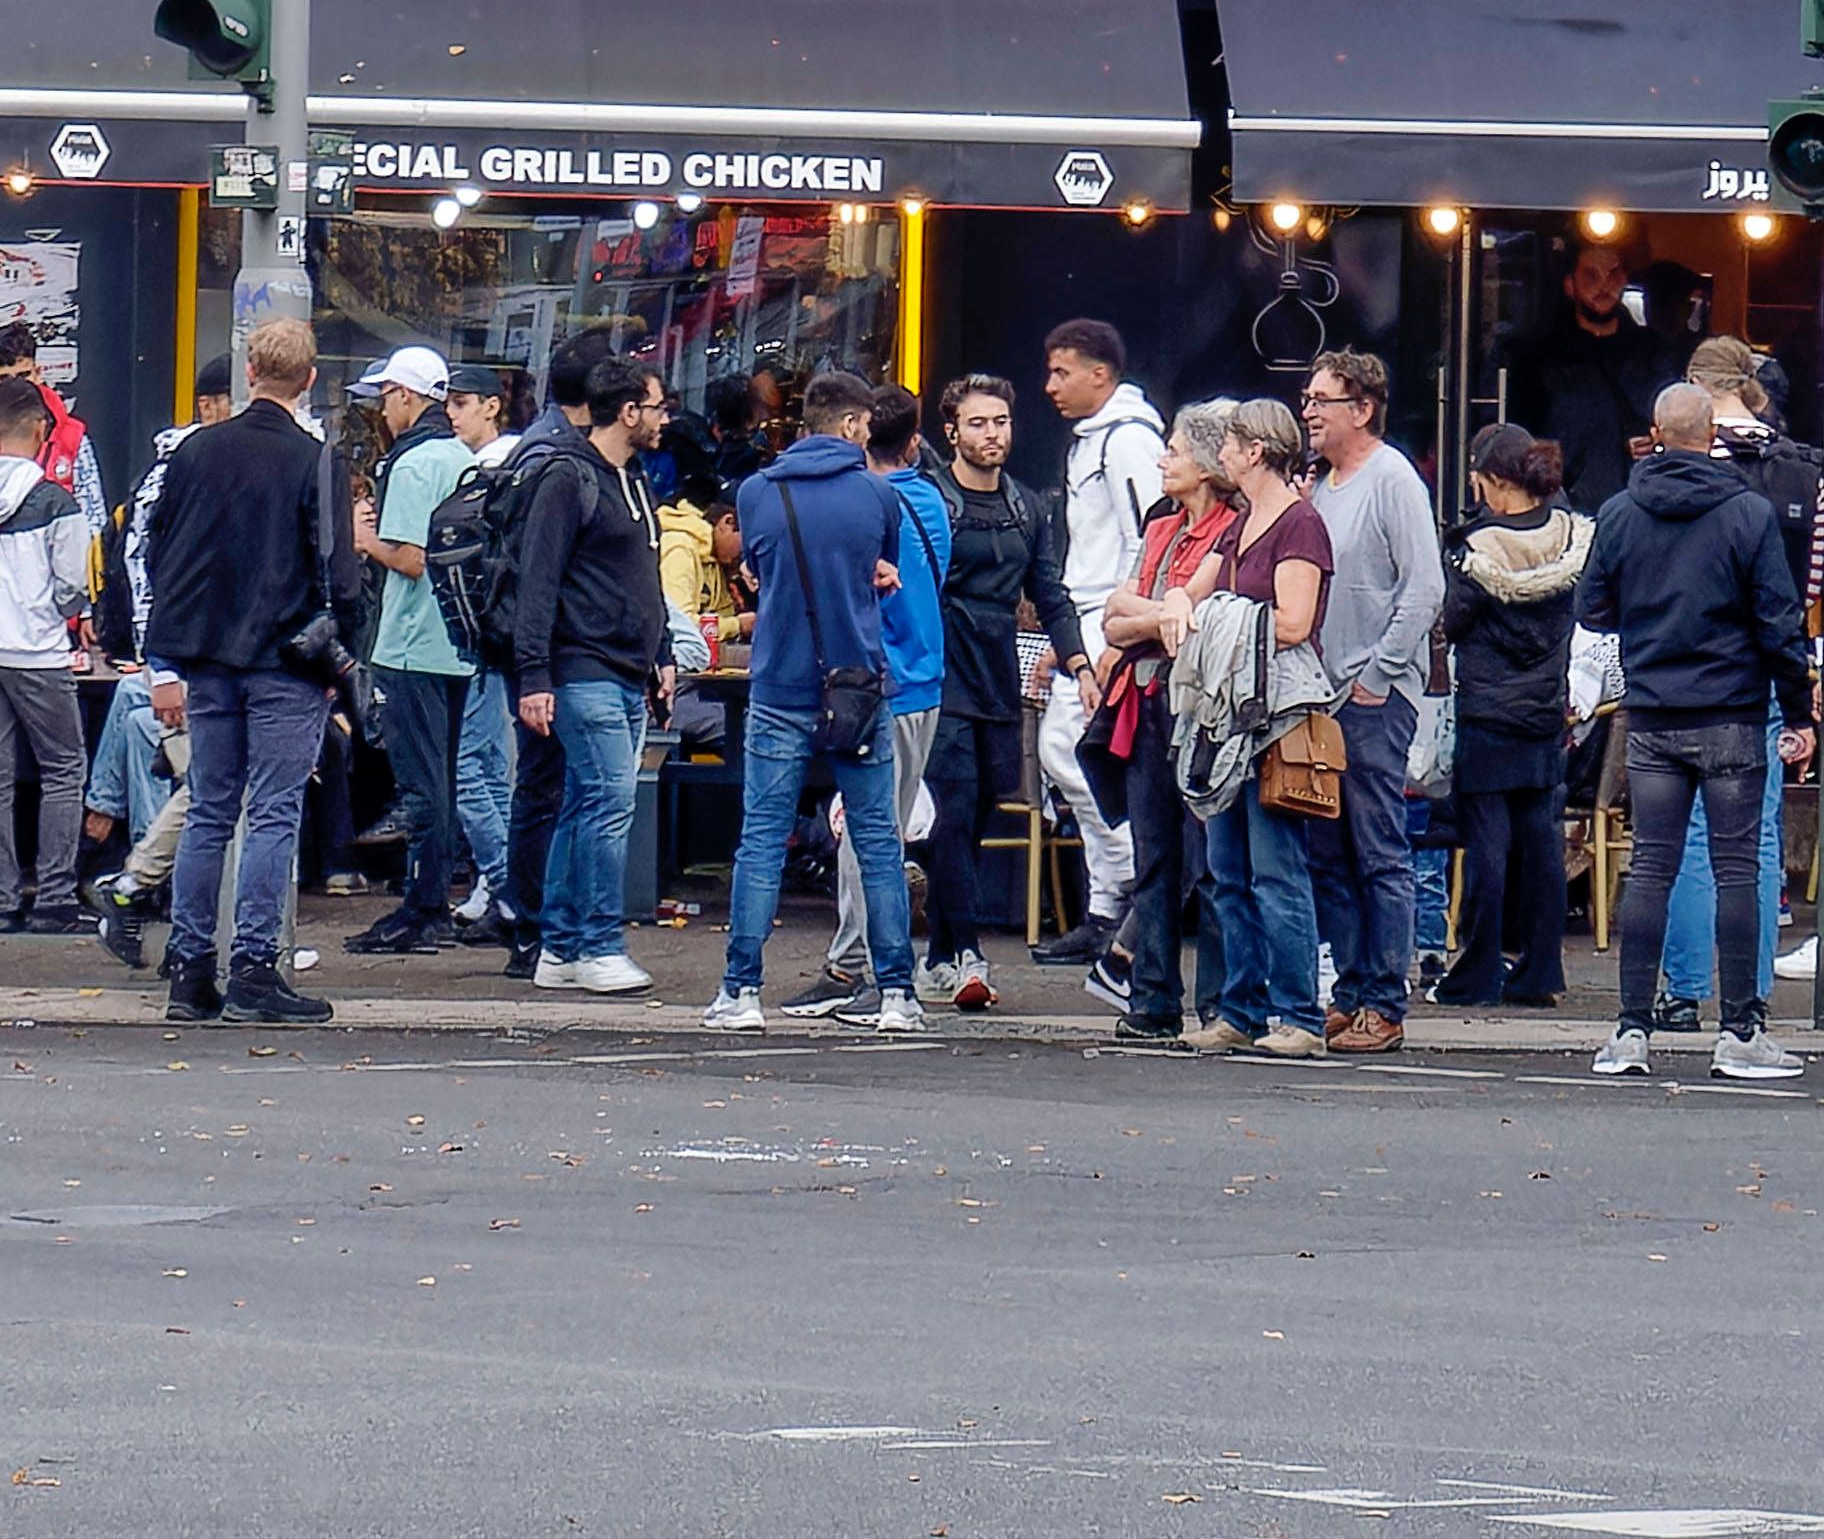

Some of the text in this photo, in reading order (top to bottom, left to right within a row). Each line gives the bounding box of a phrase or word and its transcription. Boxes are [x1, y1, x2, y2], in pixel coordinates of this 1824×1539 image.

[352, 142, 883, 193] CIAL GRILLED CHICKEN
[1702, 160, 1771, 202] يروز
